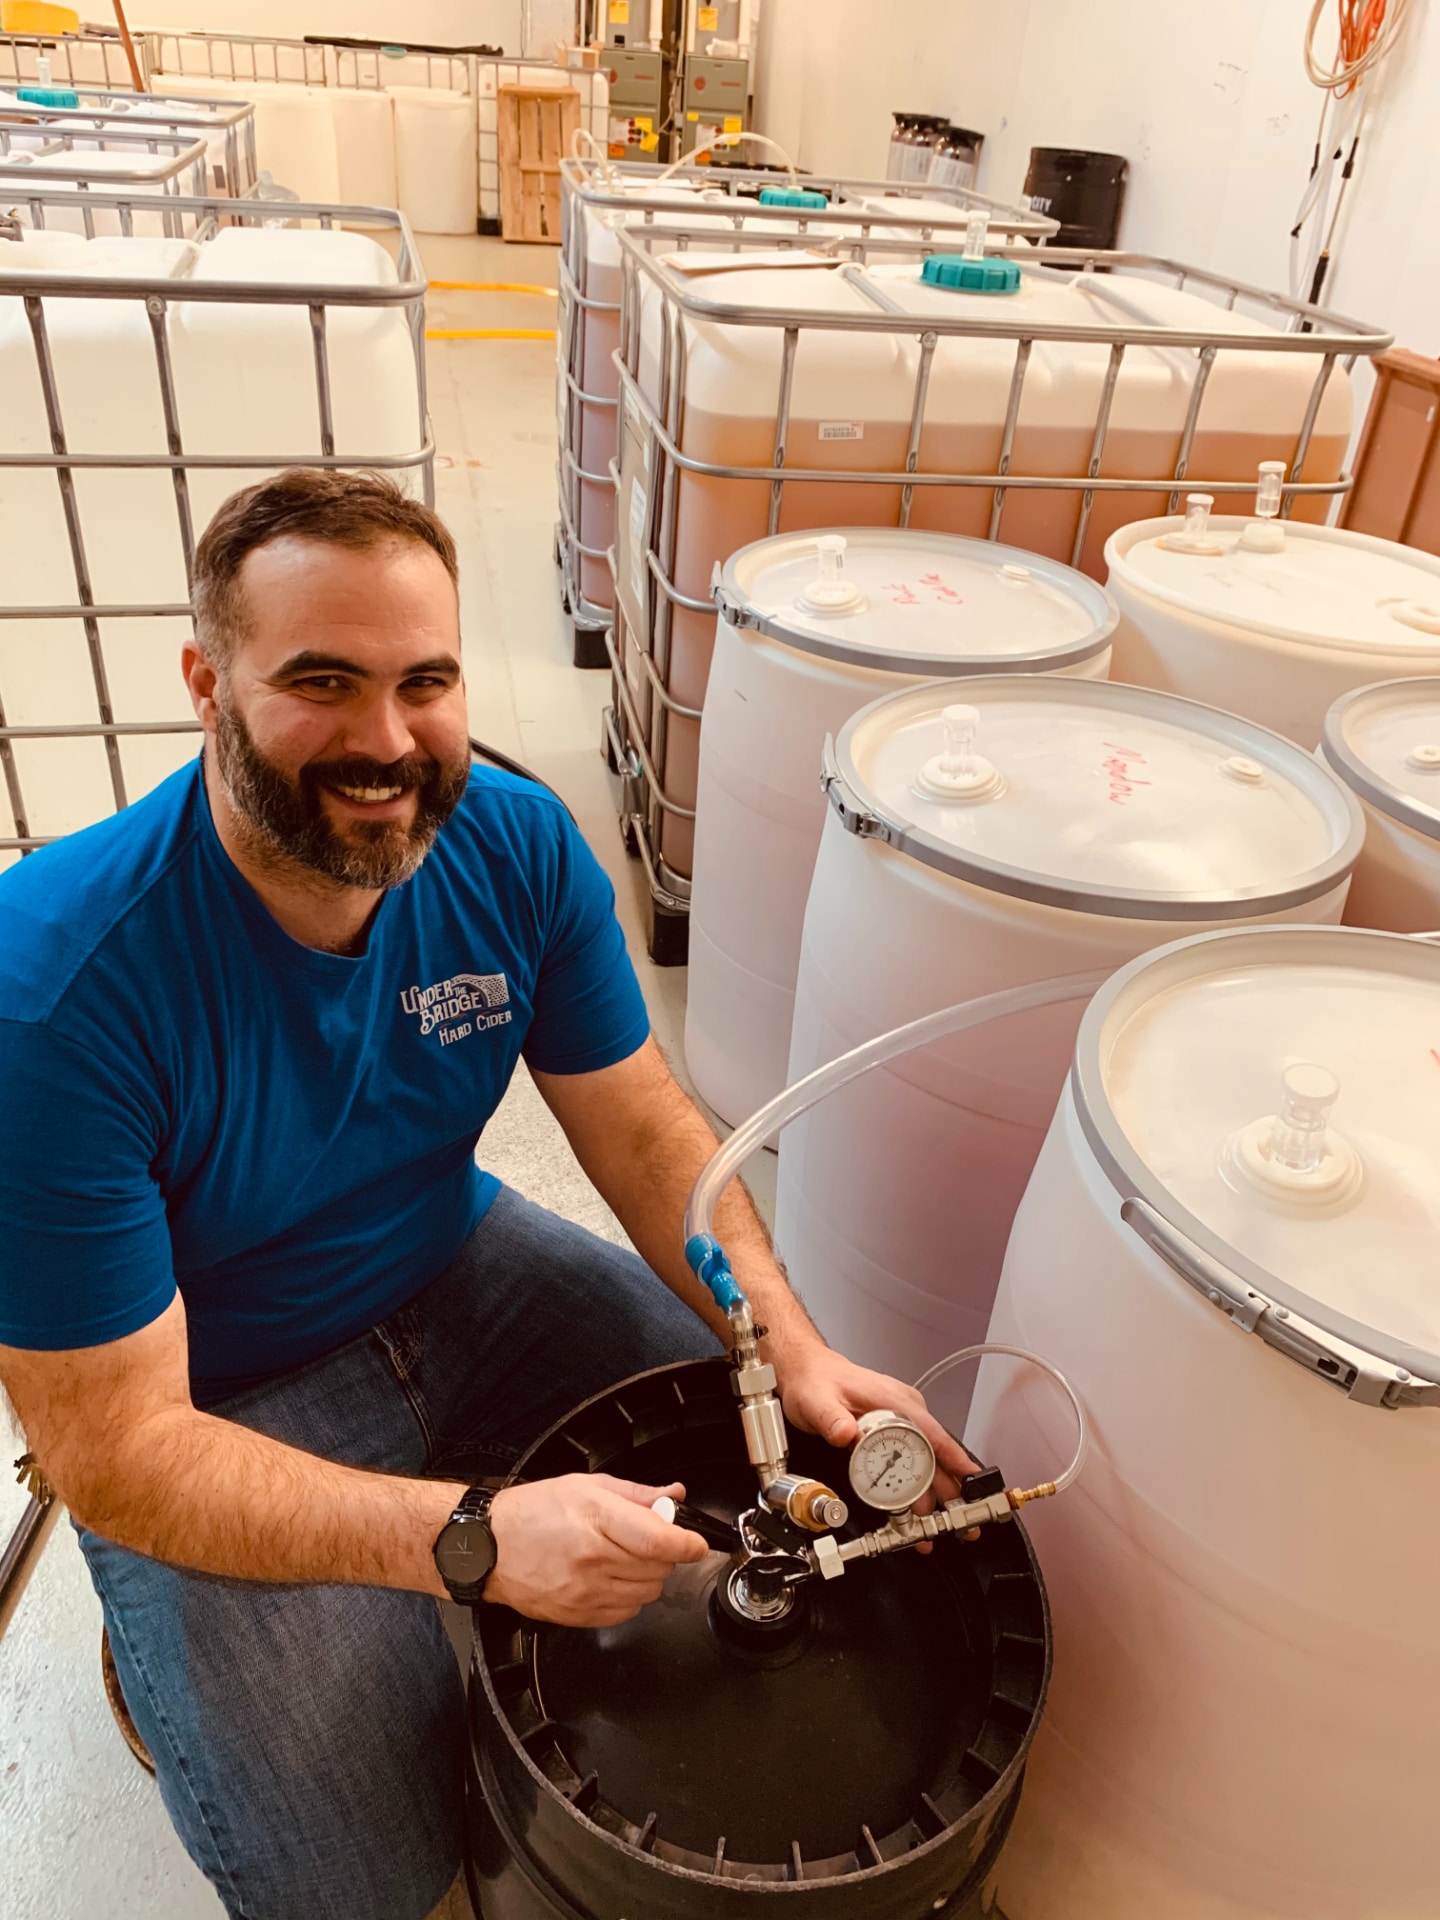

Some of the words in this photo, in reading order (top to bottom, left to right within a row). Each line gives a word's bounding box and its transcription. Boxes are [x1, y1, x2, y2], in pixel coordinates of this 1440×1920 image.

[400, 980, 453, 1014] UNDER
[453, 986, 468, 997] THE
[420, 991, 482, 1035] BRIDGE
[438, 1022, 472, 1046] HARD
[476, 1010, 512, 1031] CIDER
